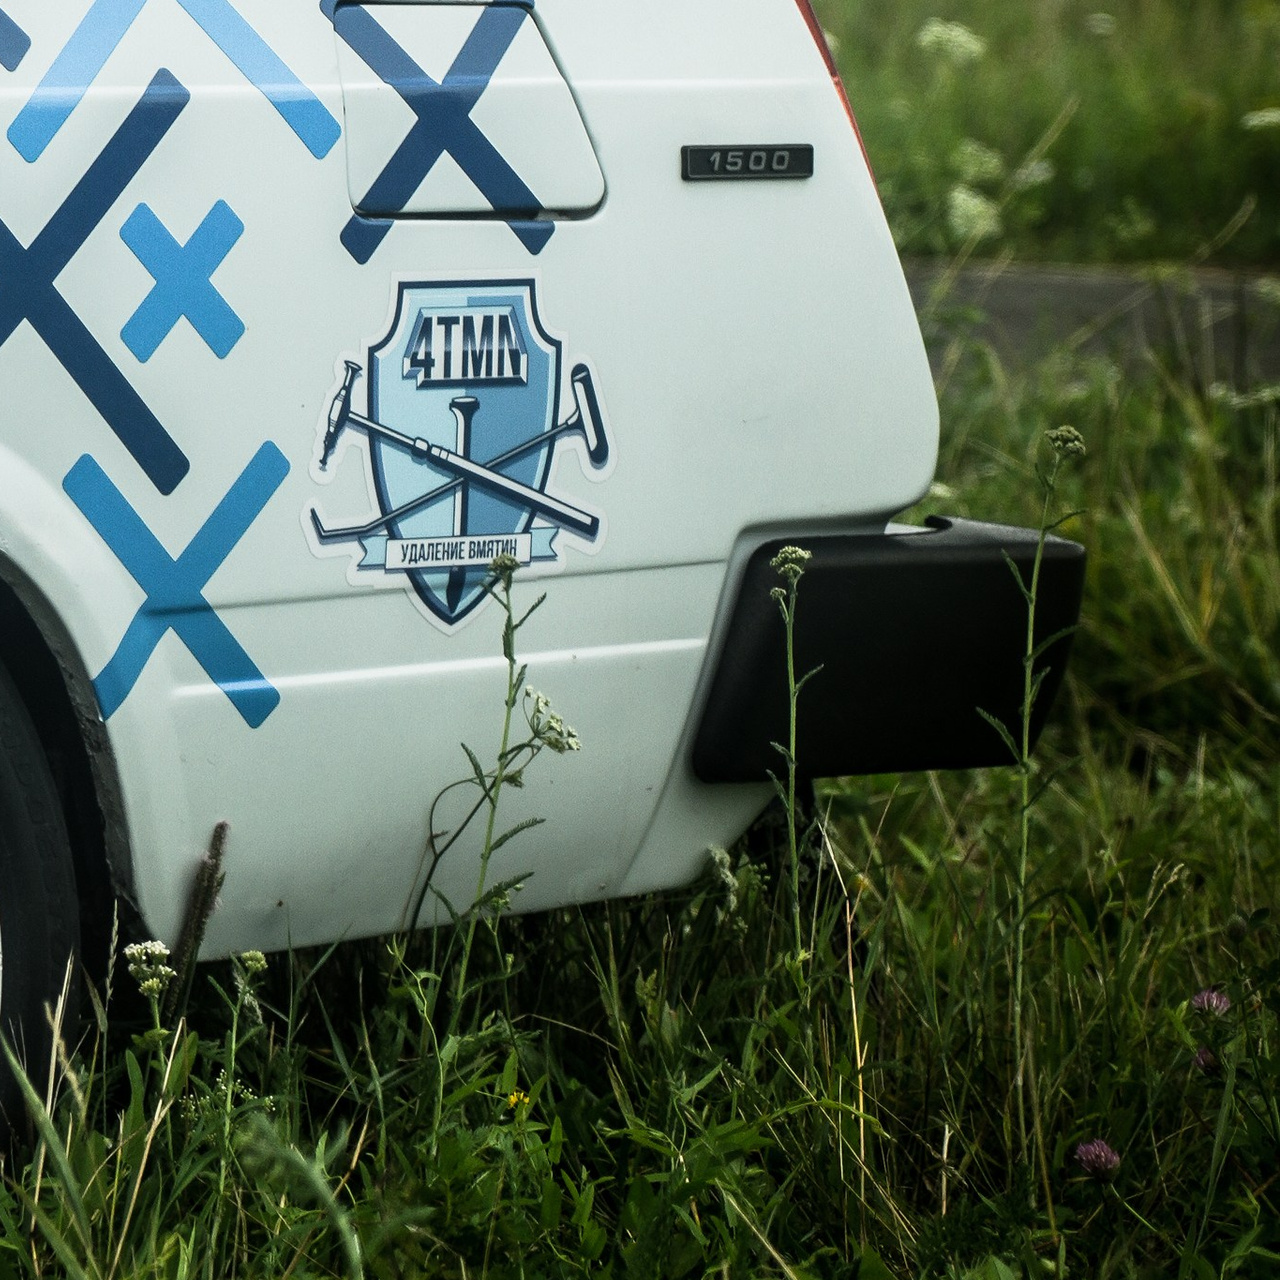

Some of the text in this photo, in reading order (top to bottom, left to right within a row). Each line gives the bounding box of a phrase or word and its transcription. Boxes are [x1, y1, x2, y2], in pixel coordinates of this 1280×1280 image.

[709, 150, 790, 172] 1500
[409, 314, 522, 380] 4TMN
[401, 539, 518, 565] УДАЛЕНИЕ ВМЯТИН
